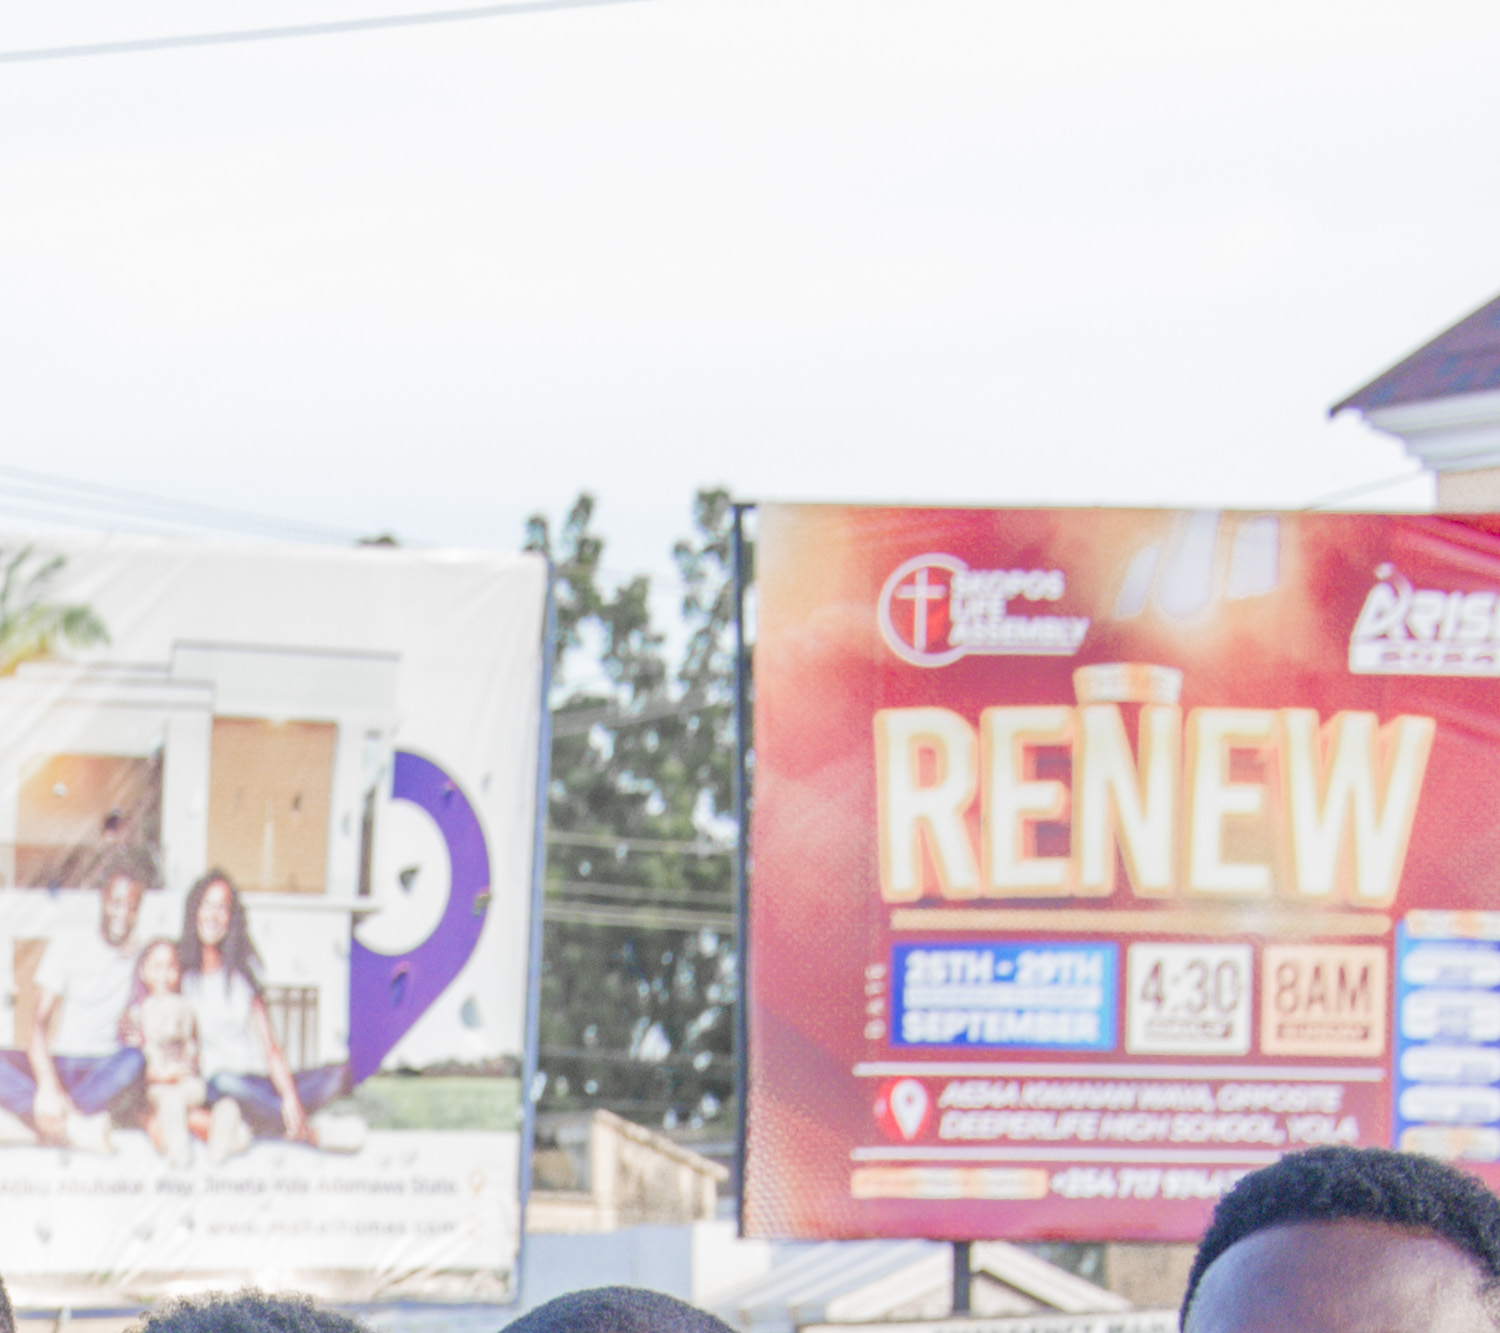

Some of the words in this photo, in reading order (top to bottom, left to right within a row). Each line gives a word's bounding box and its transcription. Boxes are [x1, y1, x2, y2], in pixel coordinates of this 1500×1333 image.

[872, 703, 1437, 904] RENEW
[1140, 958, 1241, 1013] 4:30
[1275, 960, 1371, 1014] 8AM
[901, 1008, 1102, 1044] SEPTEMBER
